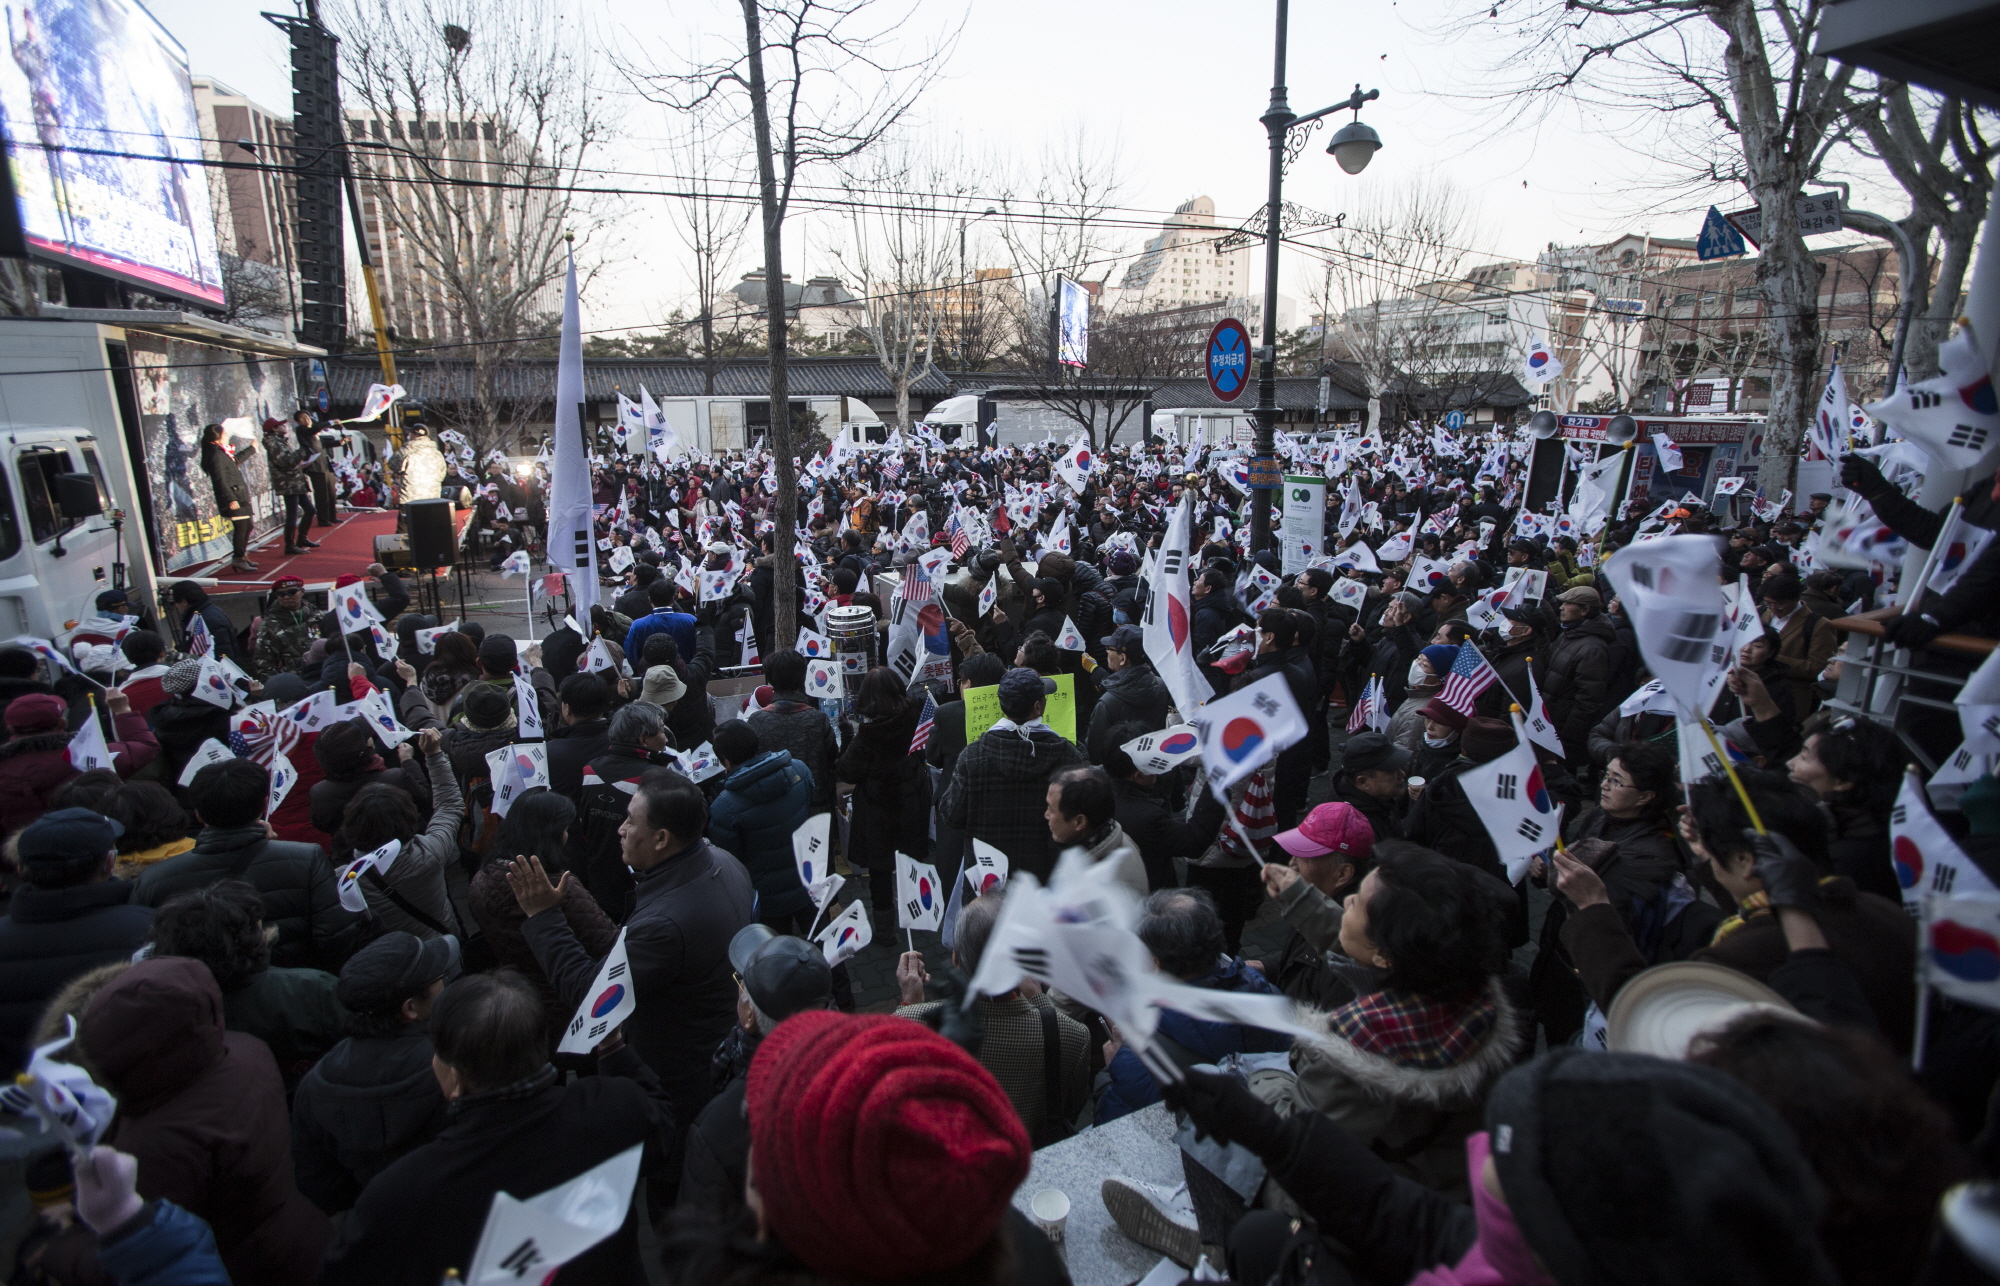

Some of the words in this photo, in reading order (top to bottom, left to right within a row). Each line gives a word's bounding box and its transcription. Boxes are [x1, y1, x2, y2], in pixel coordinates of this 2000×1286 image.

[1800, 215, 1836, 229] 대감속
[1212, 352, 1244, 367] 주정차금지
[1567, 417, 1594, 427] 탄기국
[1590, 429, 1607, 440] 국민총
[923, 660, 953, 679] 촛불은
